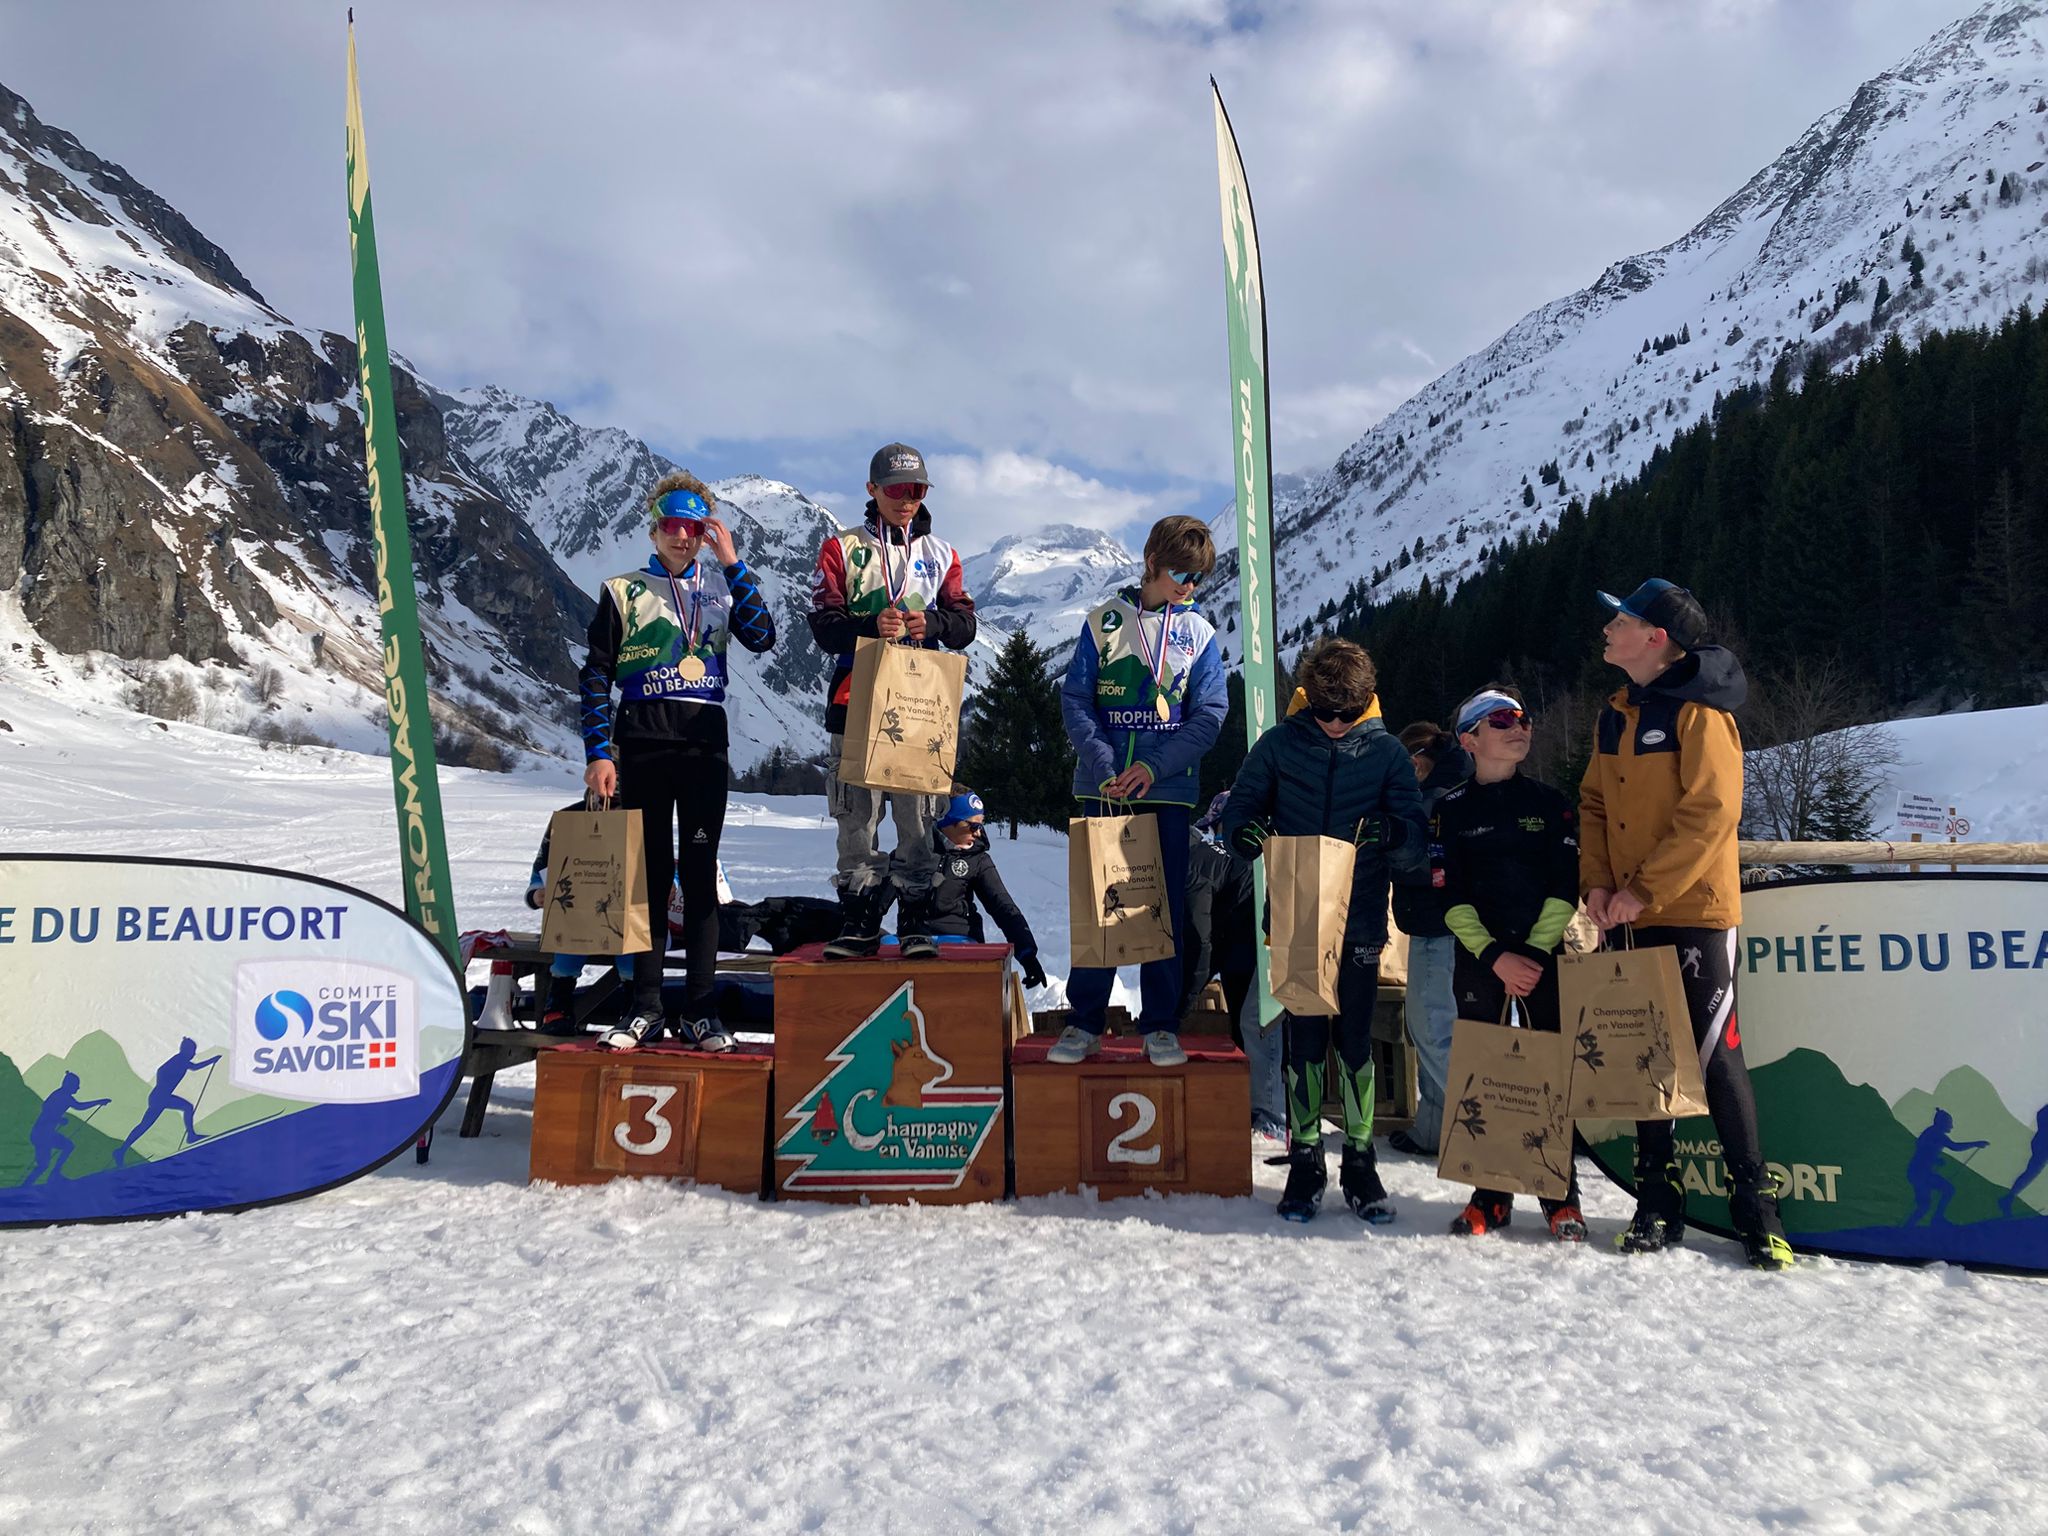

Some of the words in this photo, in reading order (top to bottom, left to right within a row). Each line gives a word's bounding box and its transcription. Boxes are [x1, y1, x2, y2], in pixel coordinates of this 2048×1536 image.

[358, 319, 394, 616] BEAUFO
[859, 549, 866, 566] 1
[1103, 611, 1116, 630] 2
[645, 667, 679, 683] TROP
[643, 682, 663, 696] DU
[665, 676, 724, 692] BEAUFORT
[1097, 685, 1127, 696] UFORT
[895, 691, 937, 707] Champagny
[907, 706, 935, 717] Vanoise
[1108, 711, 1168, 724] TROPHE
[384, 634, 440, 935] FROMAGE
[1111, 863, 1155, 874] Champagny
[1126, 875, 1155, 884] Vanoise
[32, 907, 99, 943] DU
[116, 906, 348, 942] BEAUFORT
[1738, 923, 1865, 973] PHÉE
[1879, 932, 1950, 972] DU
[319, 985, 397, 1000] COMITE
[317, 999, 397, 1042] SKI
[1593, 1007, 1648, 1018] Champagny
[1610, 1020, 1645, 1030] Vanoise
[252, 1043, 366, 1075] SAVOIE
[1482, 1077, 1542, 1097] Champagny
[1484, 1092, 1496, 1100] en
[1499, 1093, 1538, 1108] Vanoise
[612, 1085, 679, 1155] 3
[842, 1088, 978, 1152] Champagny
[1107, 1092, 1161, 1165] 2
[879, 1145, 900, 1159] en
[902, 1137, 968, 1159] Vanoise
